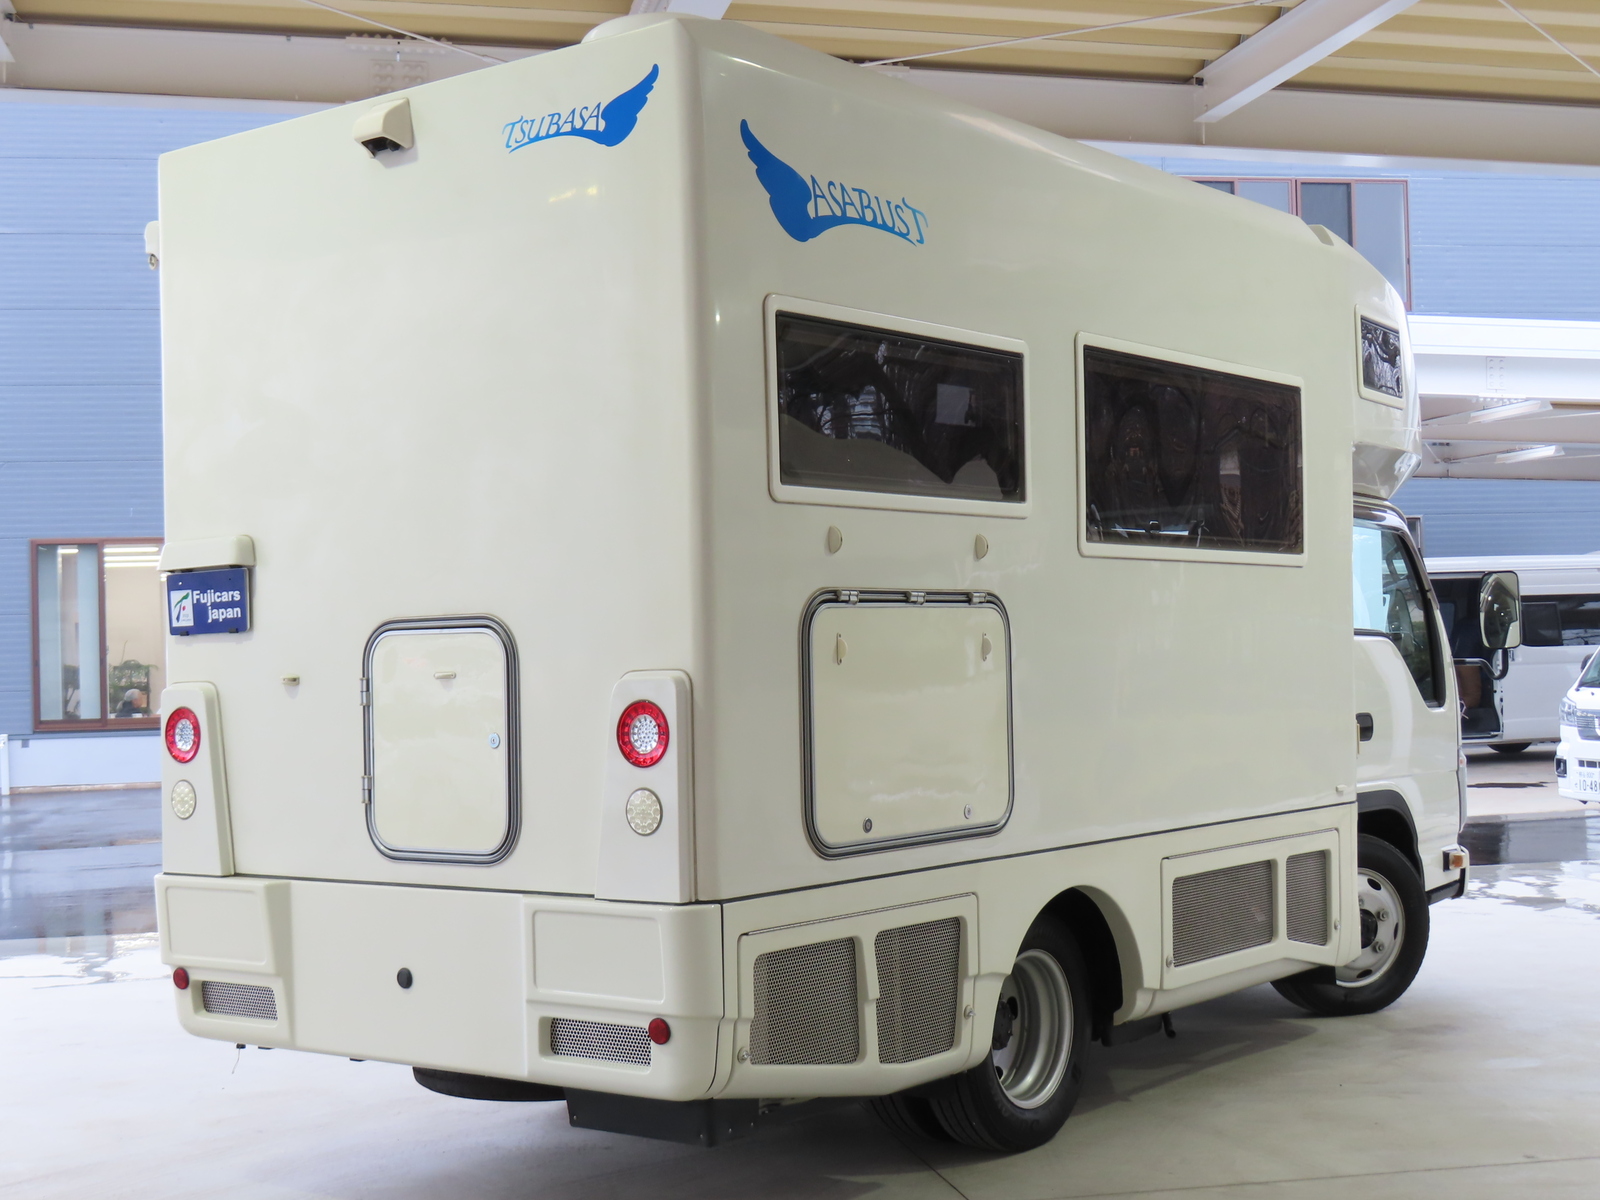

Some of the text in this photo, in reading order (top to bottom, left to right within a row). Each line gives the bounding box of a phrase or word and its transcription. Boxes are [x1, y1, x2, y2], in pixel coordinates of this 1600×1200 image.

[502, 102, 602, 149] TSUBASA
[810, 174, 928, 244] ASABUST
[193, 589, 241, 606] Fujicars
[207, 606, 241, 623] japan
[1579, 779, 1600, 792] 10-48
